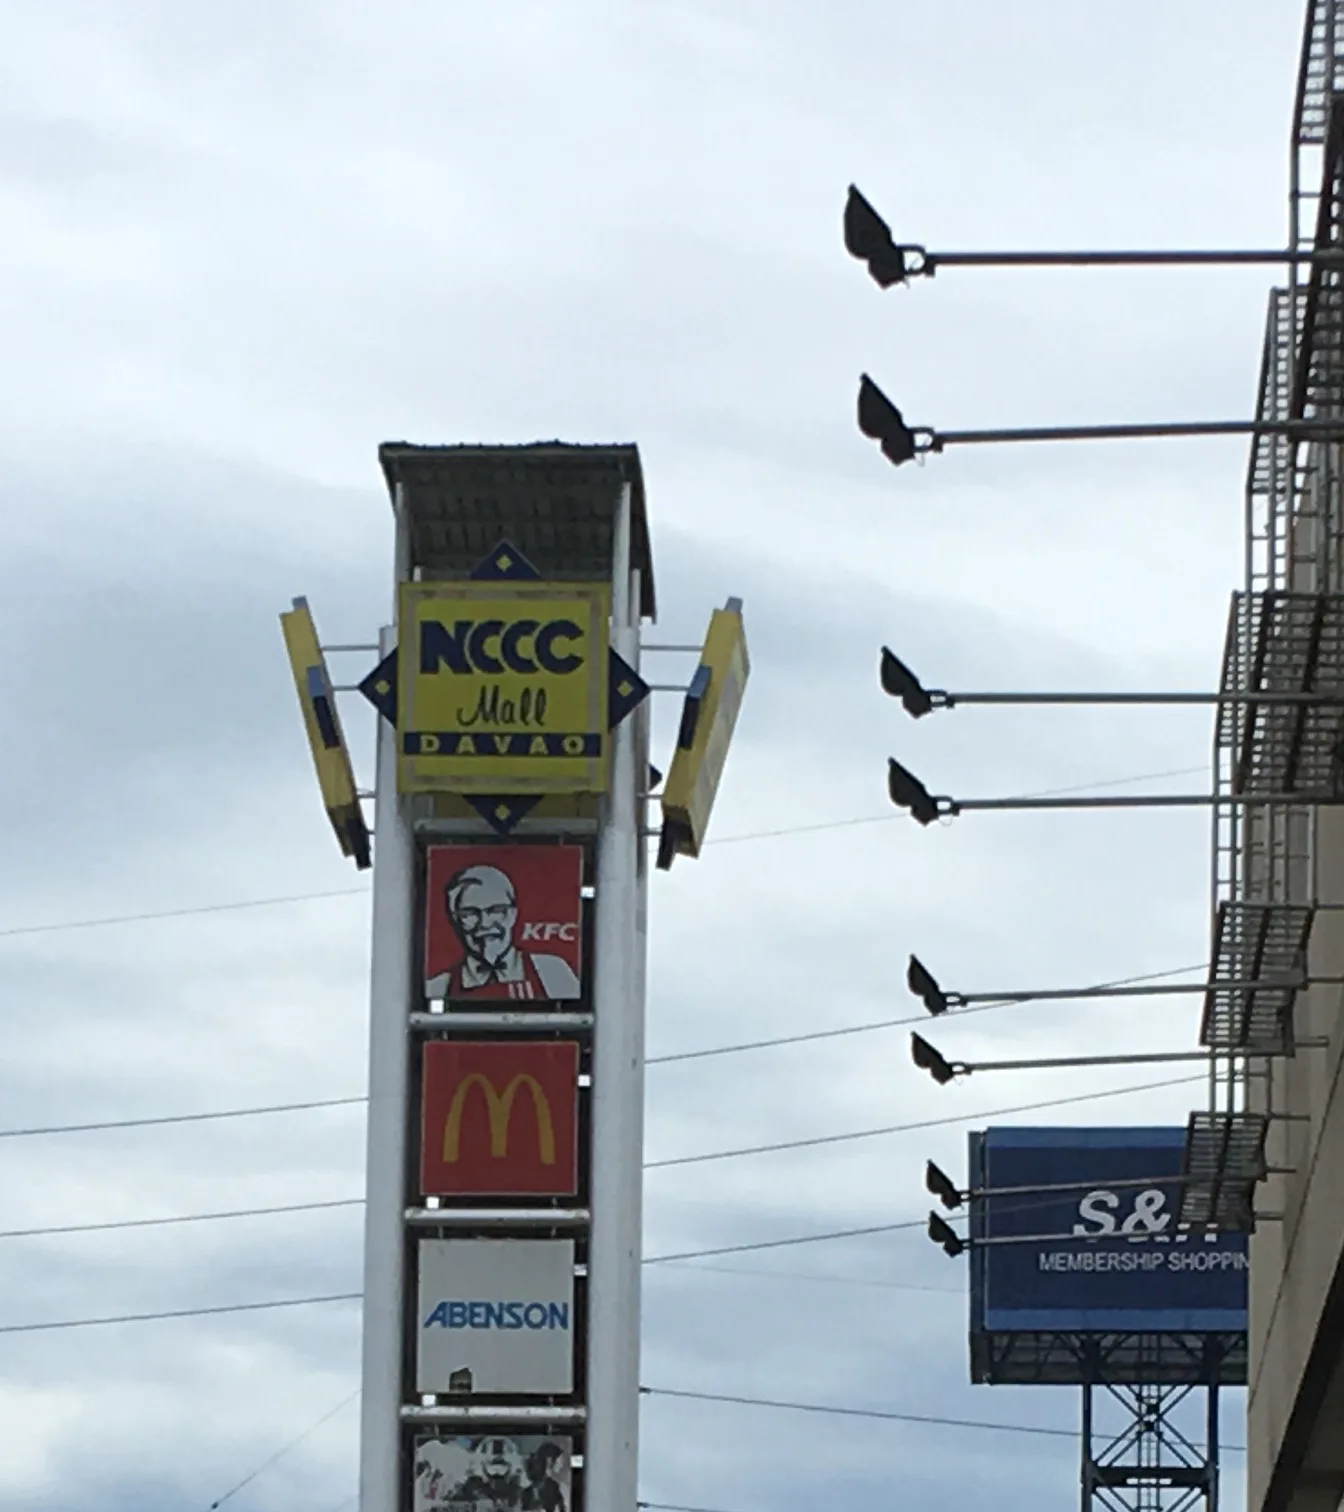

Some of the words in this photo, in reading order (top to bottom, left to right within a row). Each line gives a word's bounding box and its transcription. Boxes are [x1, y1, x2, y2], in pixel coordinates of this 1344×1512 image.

[419, 618, 584, 676] NCCC
[456, 684, 547, 728] Mall
[420, 735, 585, 756] DAVAO
[521, 922, 578, 943] KFC
[1038, 1252, 1163, 1272] MEMBERSHIP
[423, 1301, 569, 1330] ABENSON
